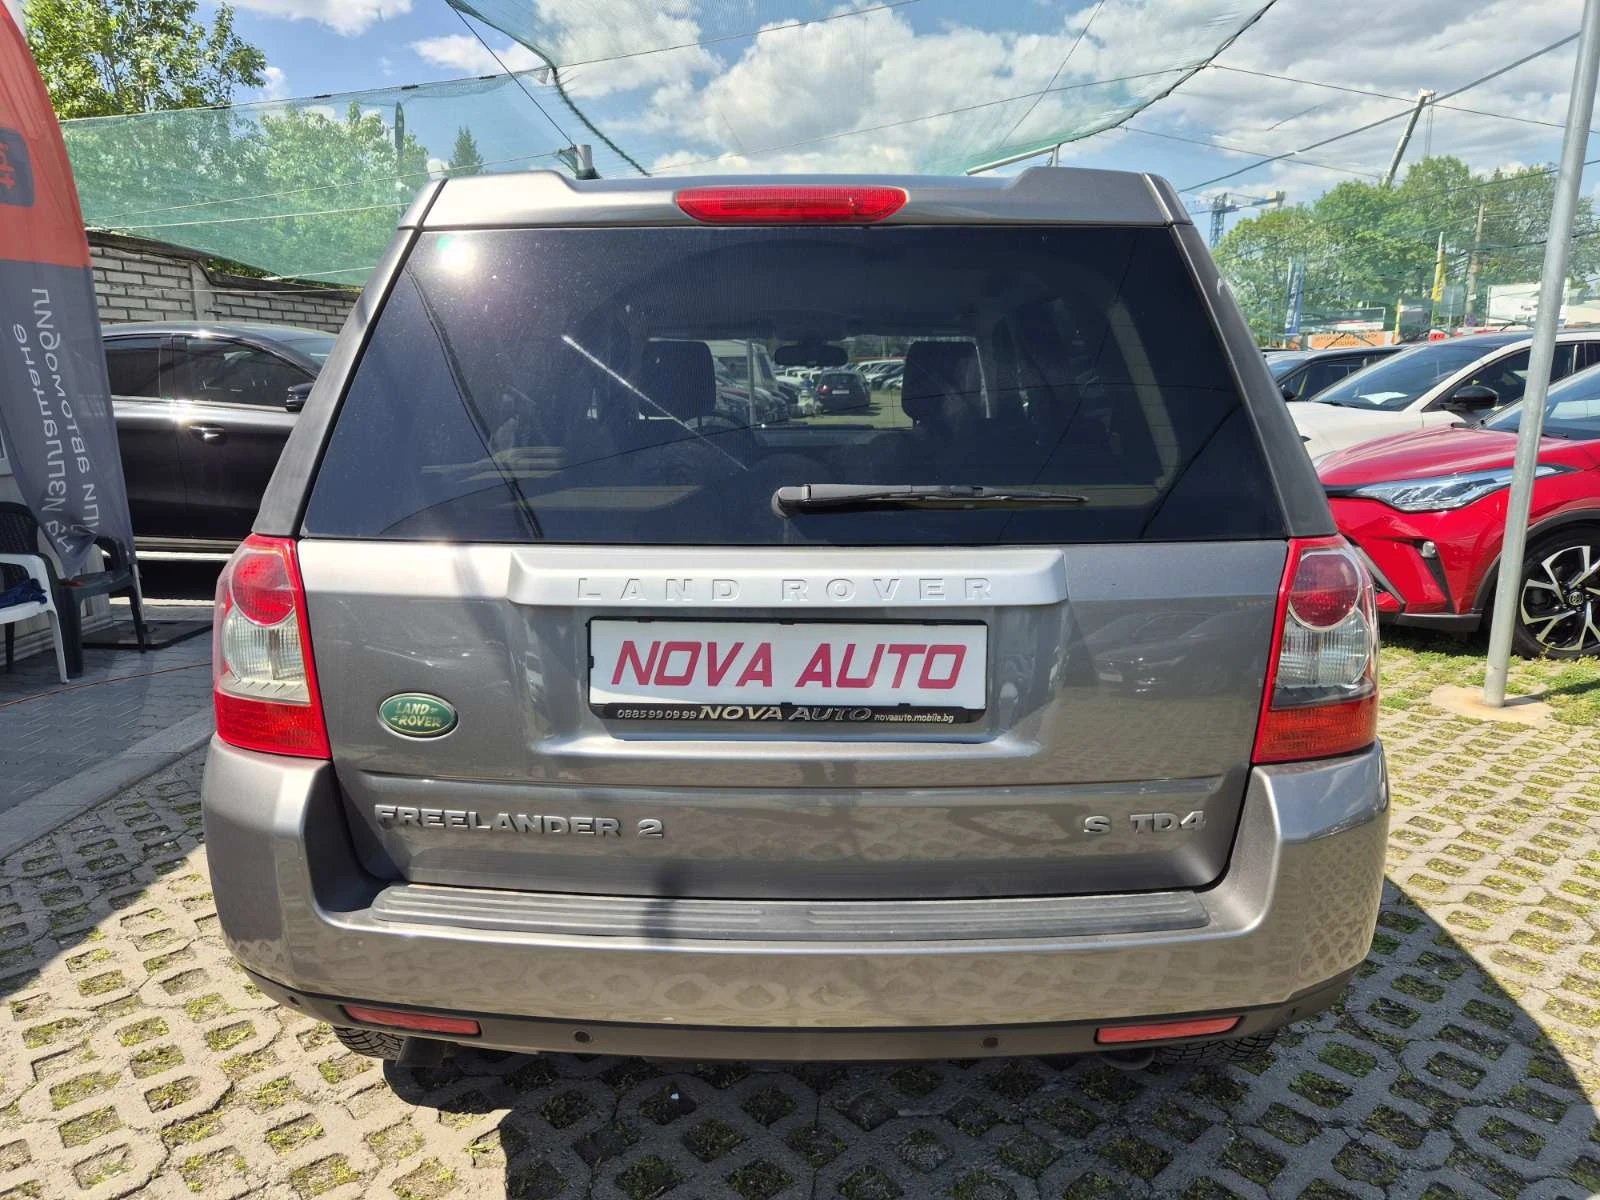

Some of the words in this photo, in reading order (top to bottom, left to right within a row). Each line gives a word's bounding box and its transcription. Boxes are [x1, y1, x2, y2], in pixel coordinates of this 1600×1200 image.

[577, 577, 741, 601] LAND
[781, 577, 994, 601] ROVER
[611, 640, 774, 688] NOVA
[794, 643, 967, 690] AUTO
[700, 705, 783, 720] NOVA
[789, 706, 872, 721] AUTO
[874, 713, 954, 724] novaauto.mobile.bg
[374, 804, 622, 837] FREELANDER
[637, 818, 664, 840] 2
[1084, 815, 1111, 835] S
[1129, 810, 1206, 834] TD4
